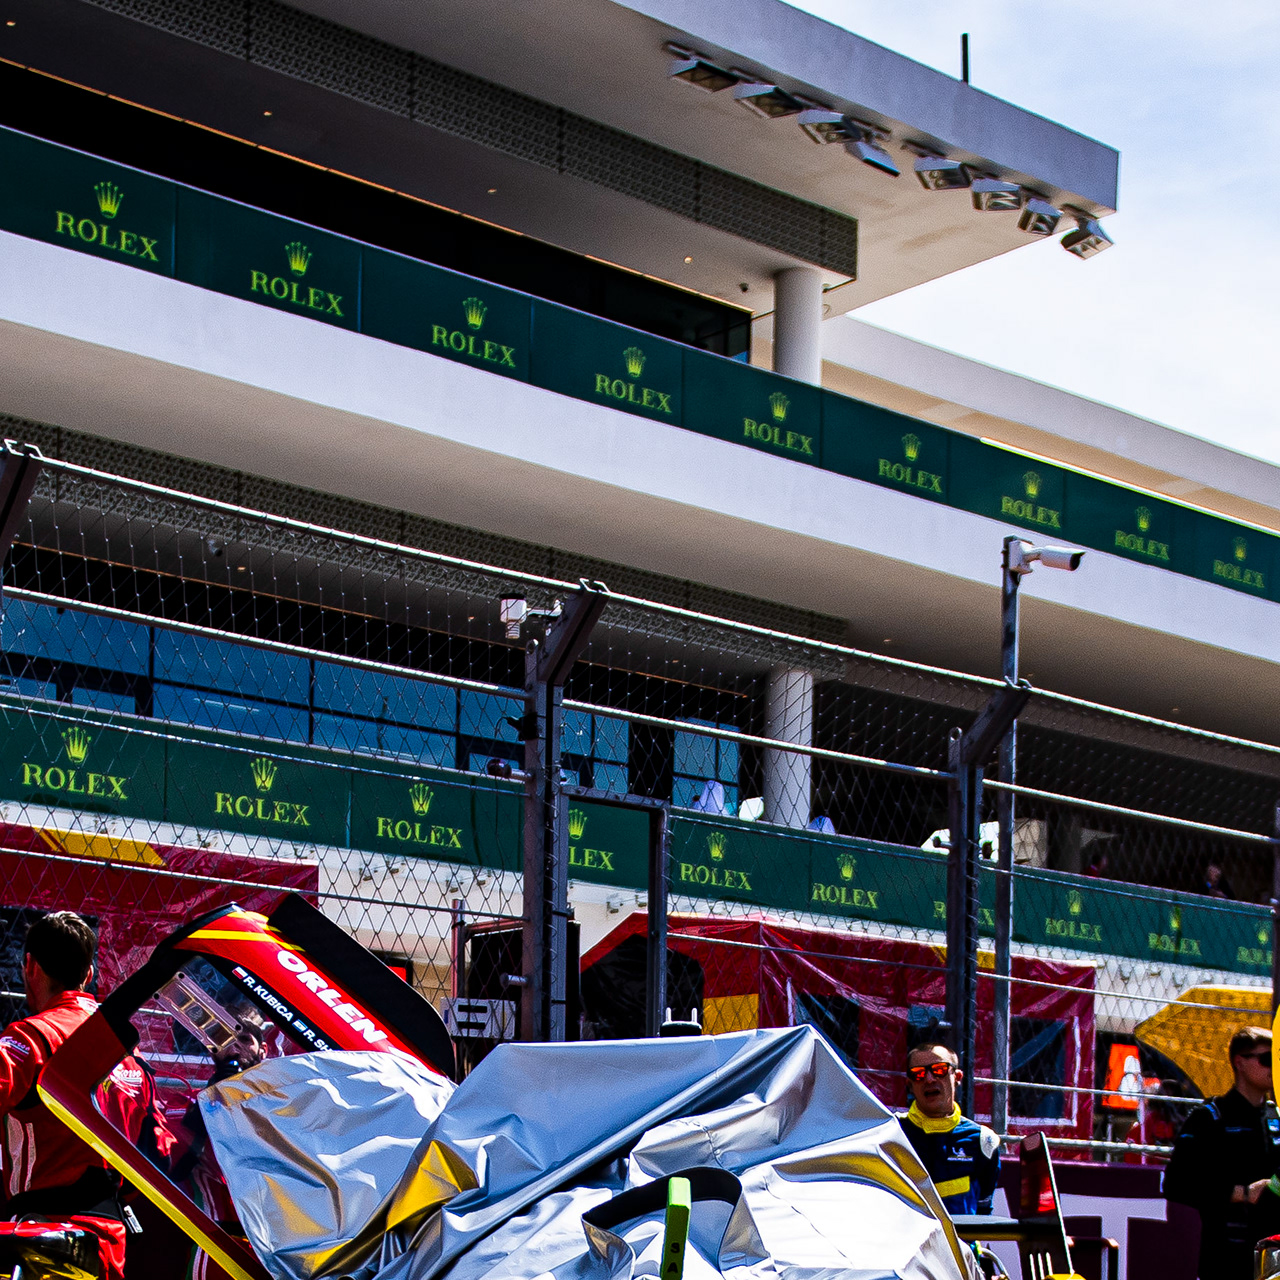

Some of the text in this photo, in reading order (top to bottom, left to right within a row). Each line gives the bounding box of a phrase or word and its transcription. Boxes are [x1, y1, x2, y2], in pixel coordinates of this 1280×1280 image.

[55, 211, 159, 262] ROLEX
[250, 269, 345, 317] ROLEX
[431, 324, 517, 368] ROLEX
[595, 373, 673, 415] ROLEX
[743, 417, 814, 457] ROLEX
[878, 458, 943, 494] ROLEX
[1001, 495, 1062, 530] ROLEX
[1114, 529, 1170, 562] ROLEX
[1213, 559, 1265, 589] ROLEX
[21, 762, 129, 801] ROLEX
[215, 790, 311, 827] ROLEX
[376, 816, 463, 850] ROLEX
[567, 844, 615, 871] LEX
[679, 862, 753, 891] ROLEX
[812, 881, 879, 910] ROLEX
[1045, 916, 1103, 942] ROLEX
[242, 975, 294, 1022] R. KUBICA
[277, 949, 388, 1044] ORLEN
[303, 1028, 315, 1042] R.
